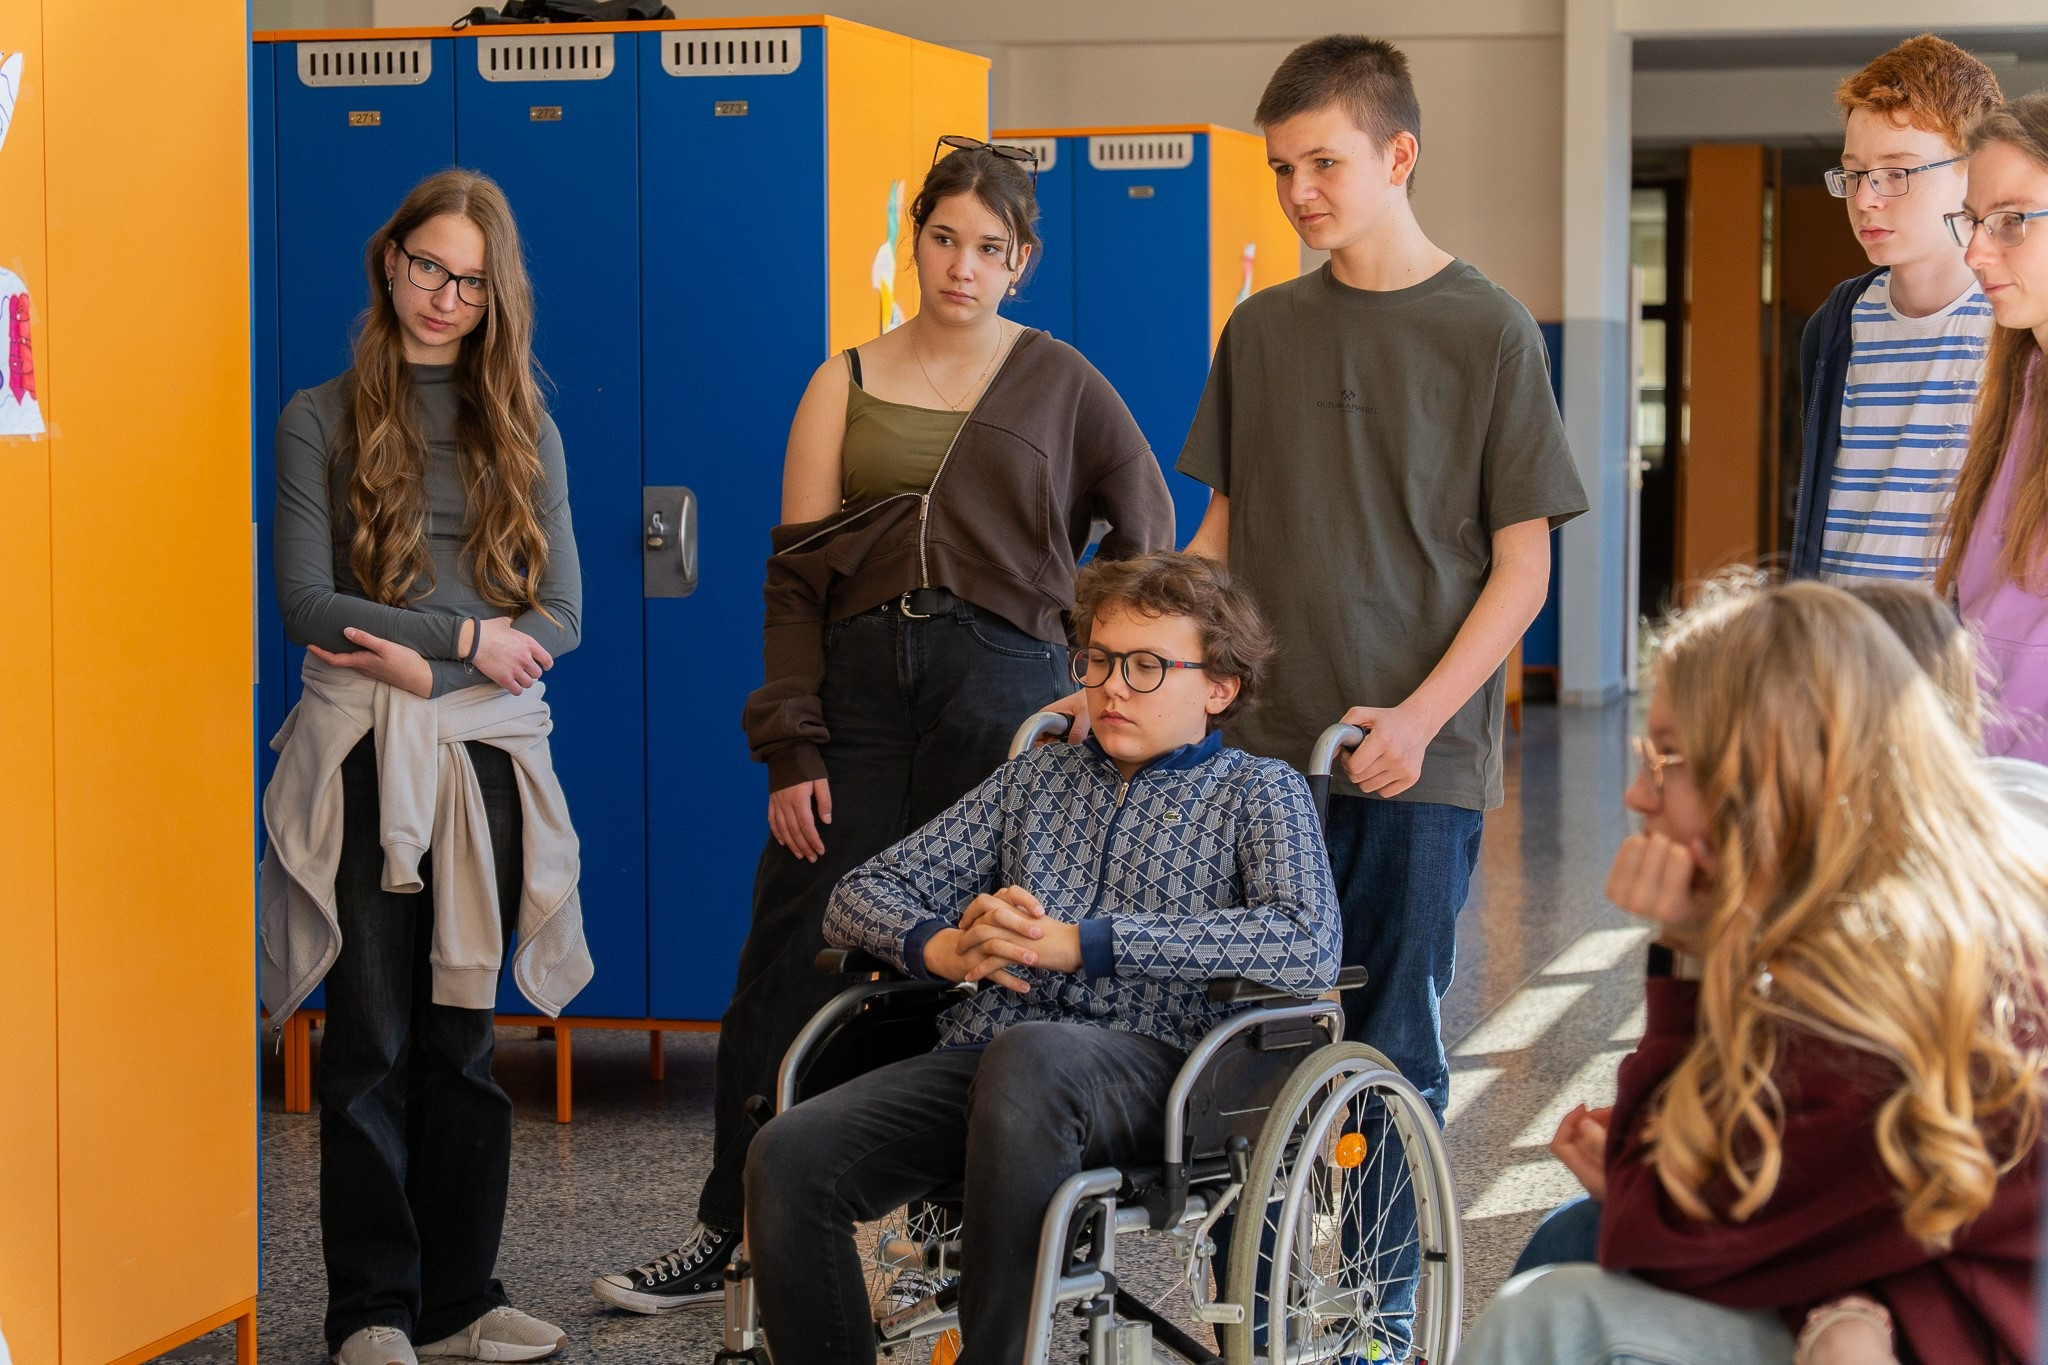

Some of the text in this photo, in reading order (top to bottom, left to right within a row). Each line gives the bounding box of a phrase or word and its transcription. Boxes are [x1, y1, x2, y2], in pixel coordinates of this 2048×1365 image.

[536, 108, 556, 119] 272
[721, 103, 742, 114] 273
[355, 113, 374, 124] 271
